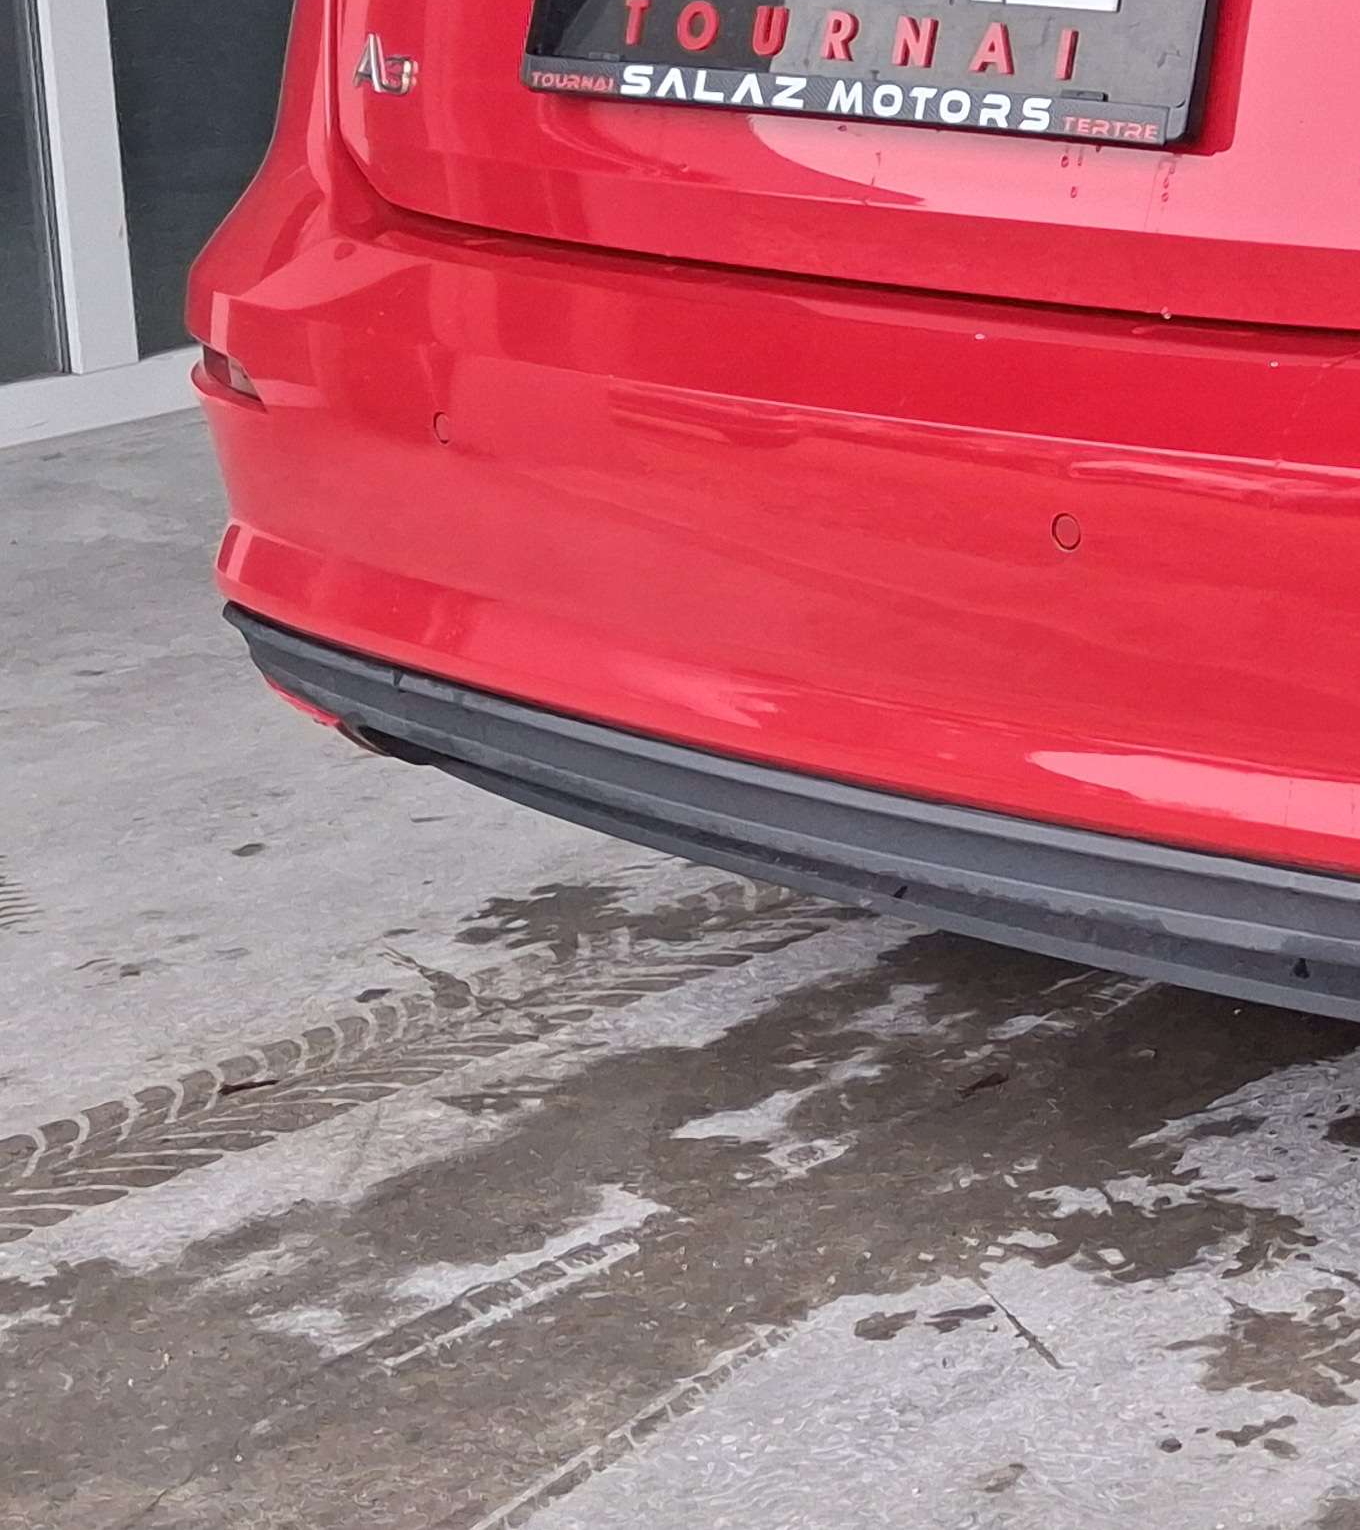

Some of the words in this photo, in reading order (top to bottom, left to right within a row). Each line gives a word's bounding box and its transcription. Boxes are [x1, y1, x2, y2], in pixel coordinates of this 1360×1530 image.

[531, 71, 615, 91] TOURNAI
[620, 65, 807, 108] SALAZ
[826, 79, 1053, 131] MOTORS
[1062, 115, 1160, 141] TERTRE
